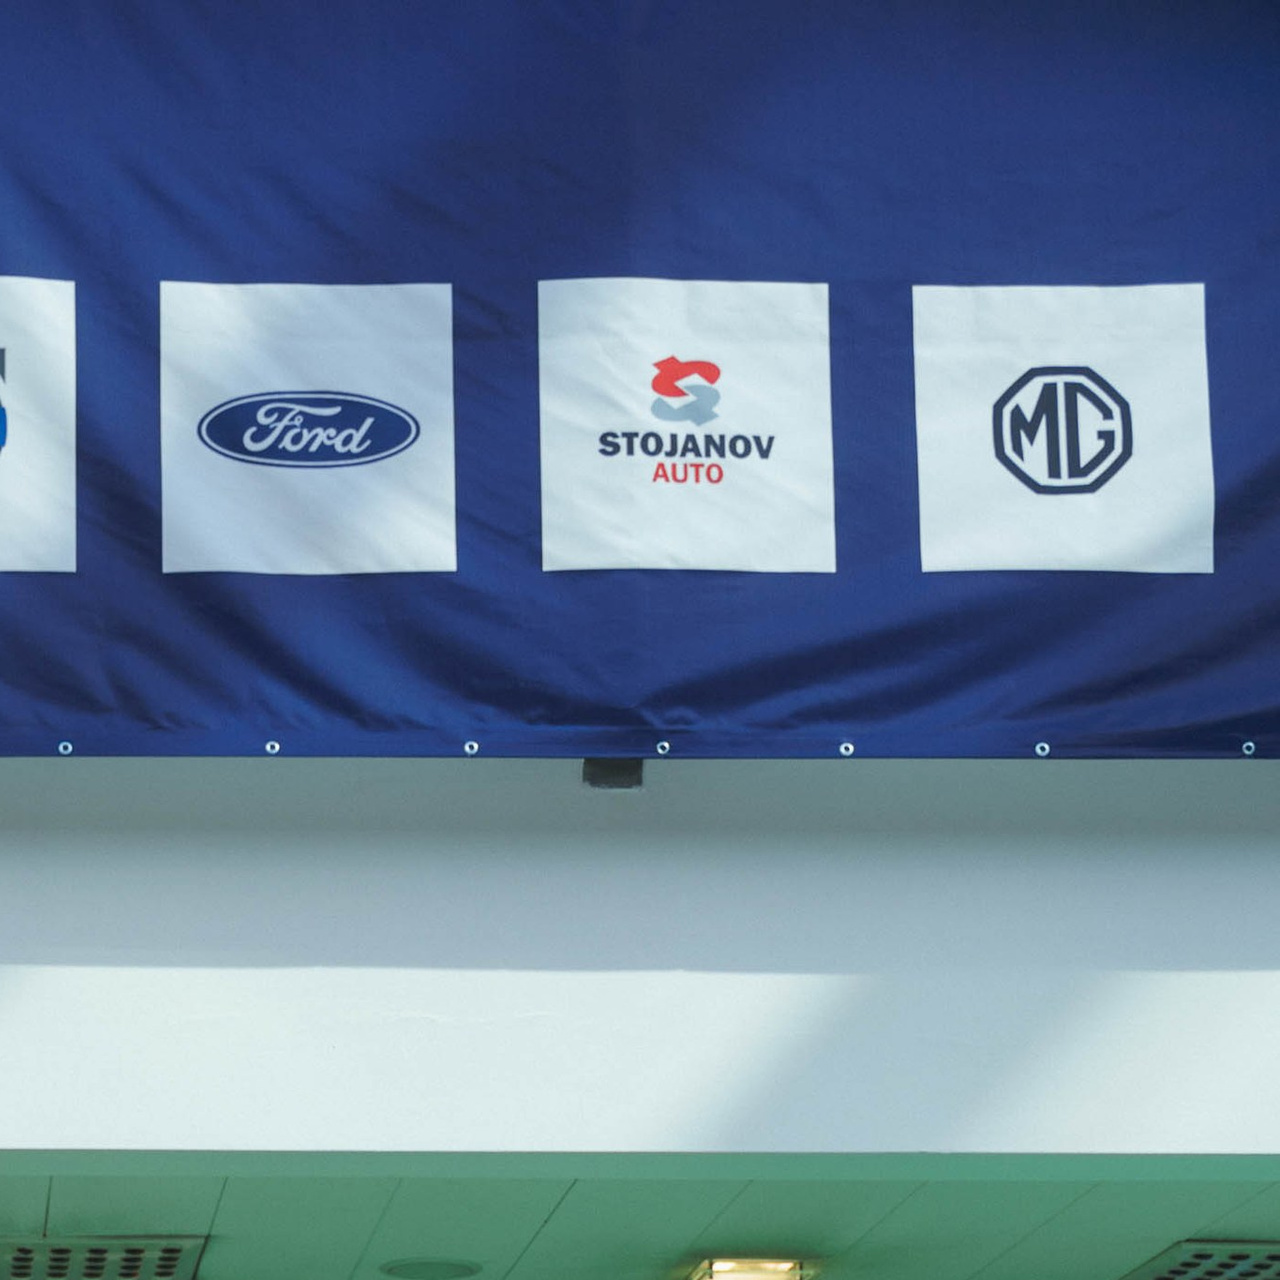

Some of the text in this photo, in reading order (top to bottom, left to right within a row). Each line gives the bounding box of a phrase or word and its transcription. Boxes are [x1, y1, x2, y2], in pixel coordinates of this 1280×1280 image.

[242, 402, 375, 453] Ford
[598, 431, 775, 459] STOJANOV
[1009, 381, 1116, 480] MG
[652, 462, 724, 484] AUTO
